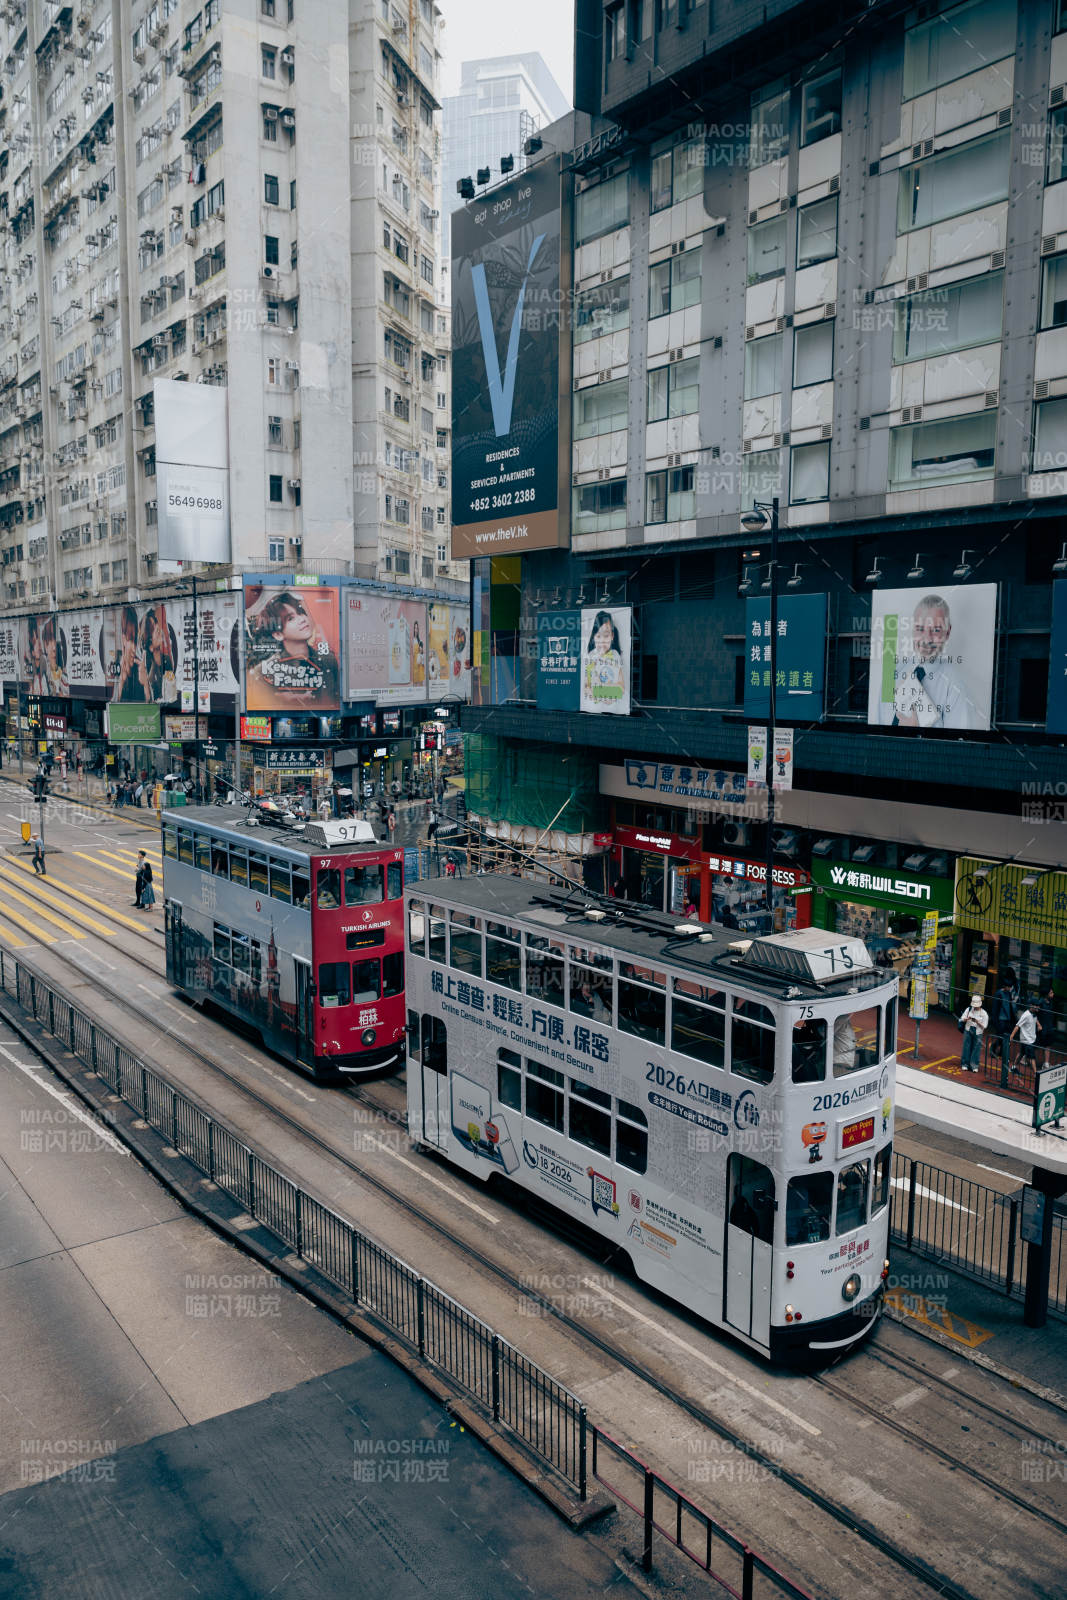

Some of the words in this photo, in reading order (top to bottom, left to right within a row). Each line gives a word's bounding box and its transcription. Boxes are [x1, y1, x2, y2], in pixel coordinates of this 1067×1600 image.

[474, 208, 487, 224] eat
[493, 198, 512, 215] shop
[518, 187, 532, 201] live
[471, 233, 547, 438] V
[485, 447, 520, 463] RESIDENCES
[500, 463, 505, 471] &
[470, 475, 498, 489] SERVICED
[498, 468, 535, 484] APARTMENTS
[470, 497, 490, 511] +852
[491, 493, 512, 508] 3602
[514, 488, 536, 504] 2388
[475, 524, 529, 543] www.theV.hk
[751, 645, 772, 661] 找書
[261, 660, 316, 678] Keung's
[894, 670, 934, 680] BOOS
[273, 672, 323, 688] Family
[751, 670, 813, 687] 為書找讀者
[113, 724, 157, 733] Pricerite
[338, 825, 357, 839] 97
[320, 859, 332, 868] 97
[747, 864, 795, 885] FORRESS
[341, 925, 368, 933] TURKISH
[368, 920, 391, 929] AIRLINES
[823, 946, 854, 973] 75
[358, 1013, 378, 1026] 柏林
[799, 1006, 814, 1019] 75
[441, 1001, 460, 1016] Online
[460, 1009, 485, 1027] Census:
[510, 1030, 550, 1055] Convenient
[551, 1049, 565, 1061] and
[566, 1053, 594, 1074] Secure
[645, 1062, 686, 1095] 2026
[687, 1080, 732, 1109] 人口普查
[812, 1090, 850, 1111] 2026
[678, 1106, 697, 1120] Year
[697, 1116, 723, 1133] Round
[843, 1123, 858, 1135] North
[859, 1118, 873, 1129] Point
[540, 1156, 549, 1170] 18
[550, 1162, 572, 1183] 2026
[820, 1268, 833, 1276] Your
